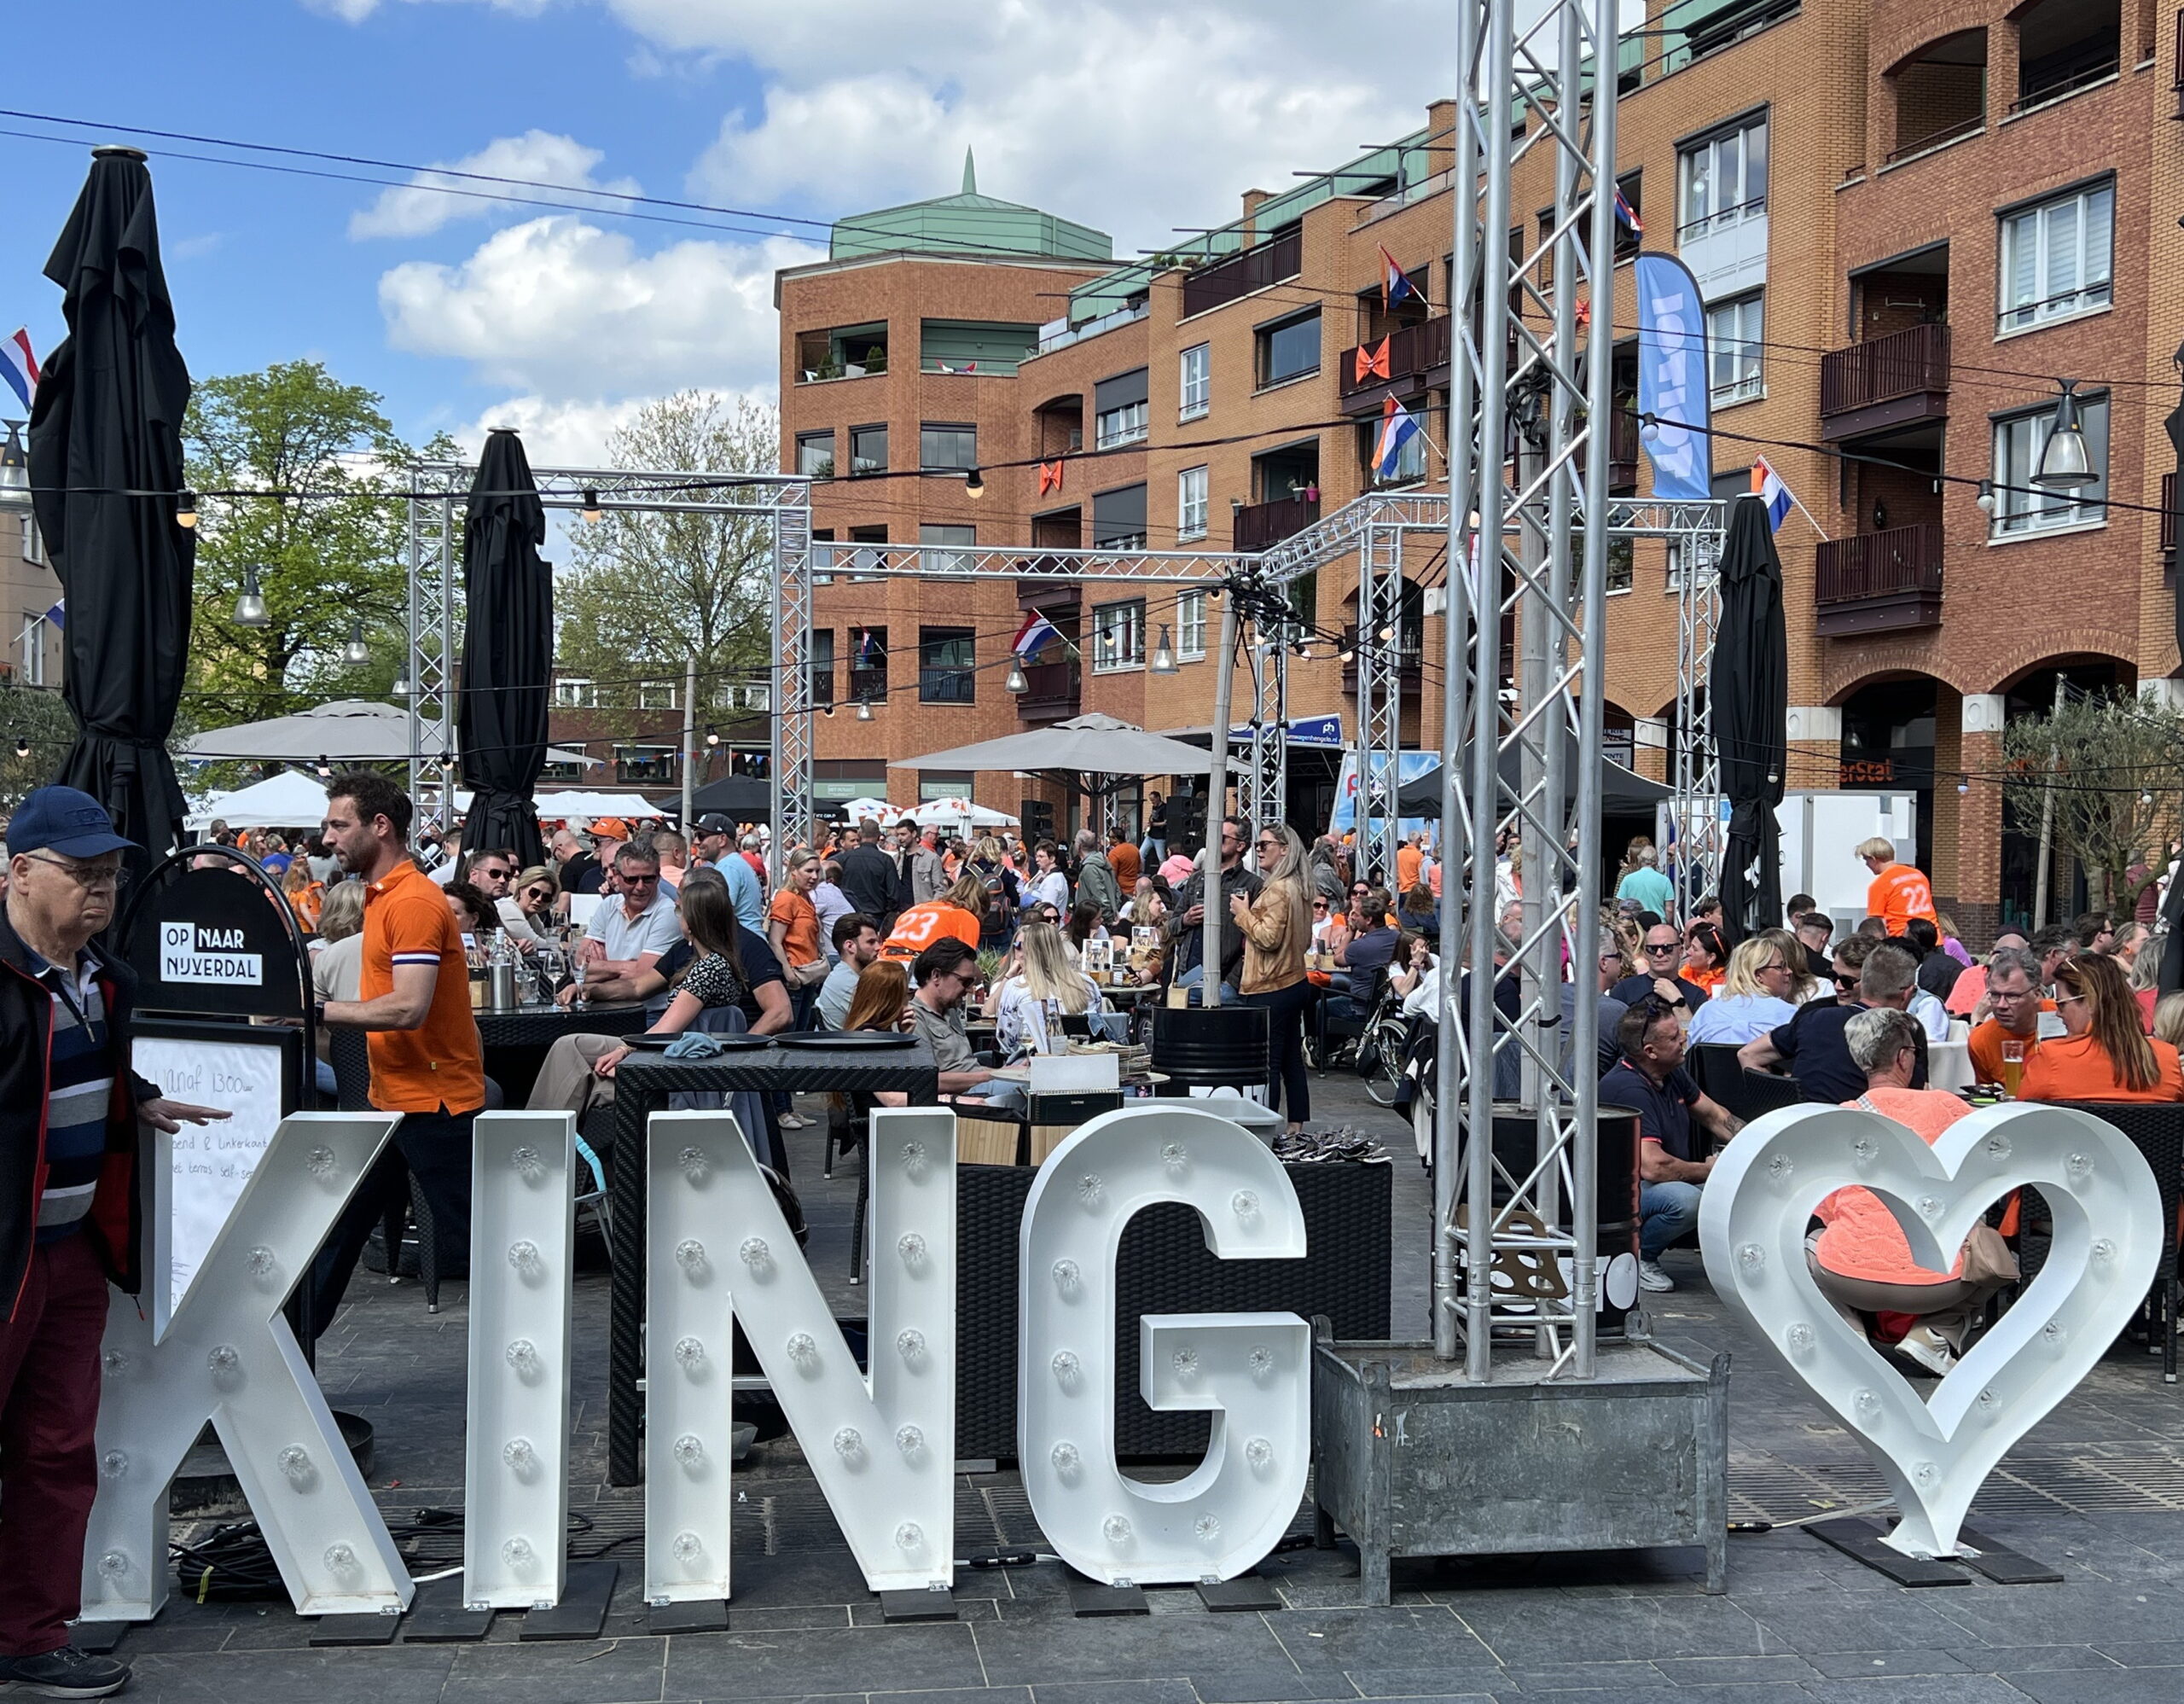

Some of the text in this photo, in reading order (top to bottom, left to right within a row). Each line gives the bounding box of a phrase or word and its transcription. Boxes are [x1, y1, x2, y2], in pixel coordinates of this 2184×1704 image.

[1902, 884, 1931, 915] 22
[166, 928, 245, 949] OP NAAR
[889, 911, 939, 941] 23
[166, 957, 257, 979] NIJVERDAL
[171, 1162, 183, 1174] et
[77, 1107, 1312, 1625] KING
